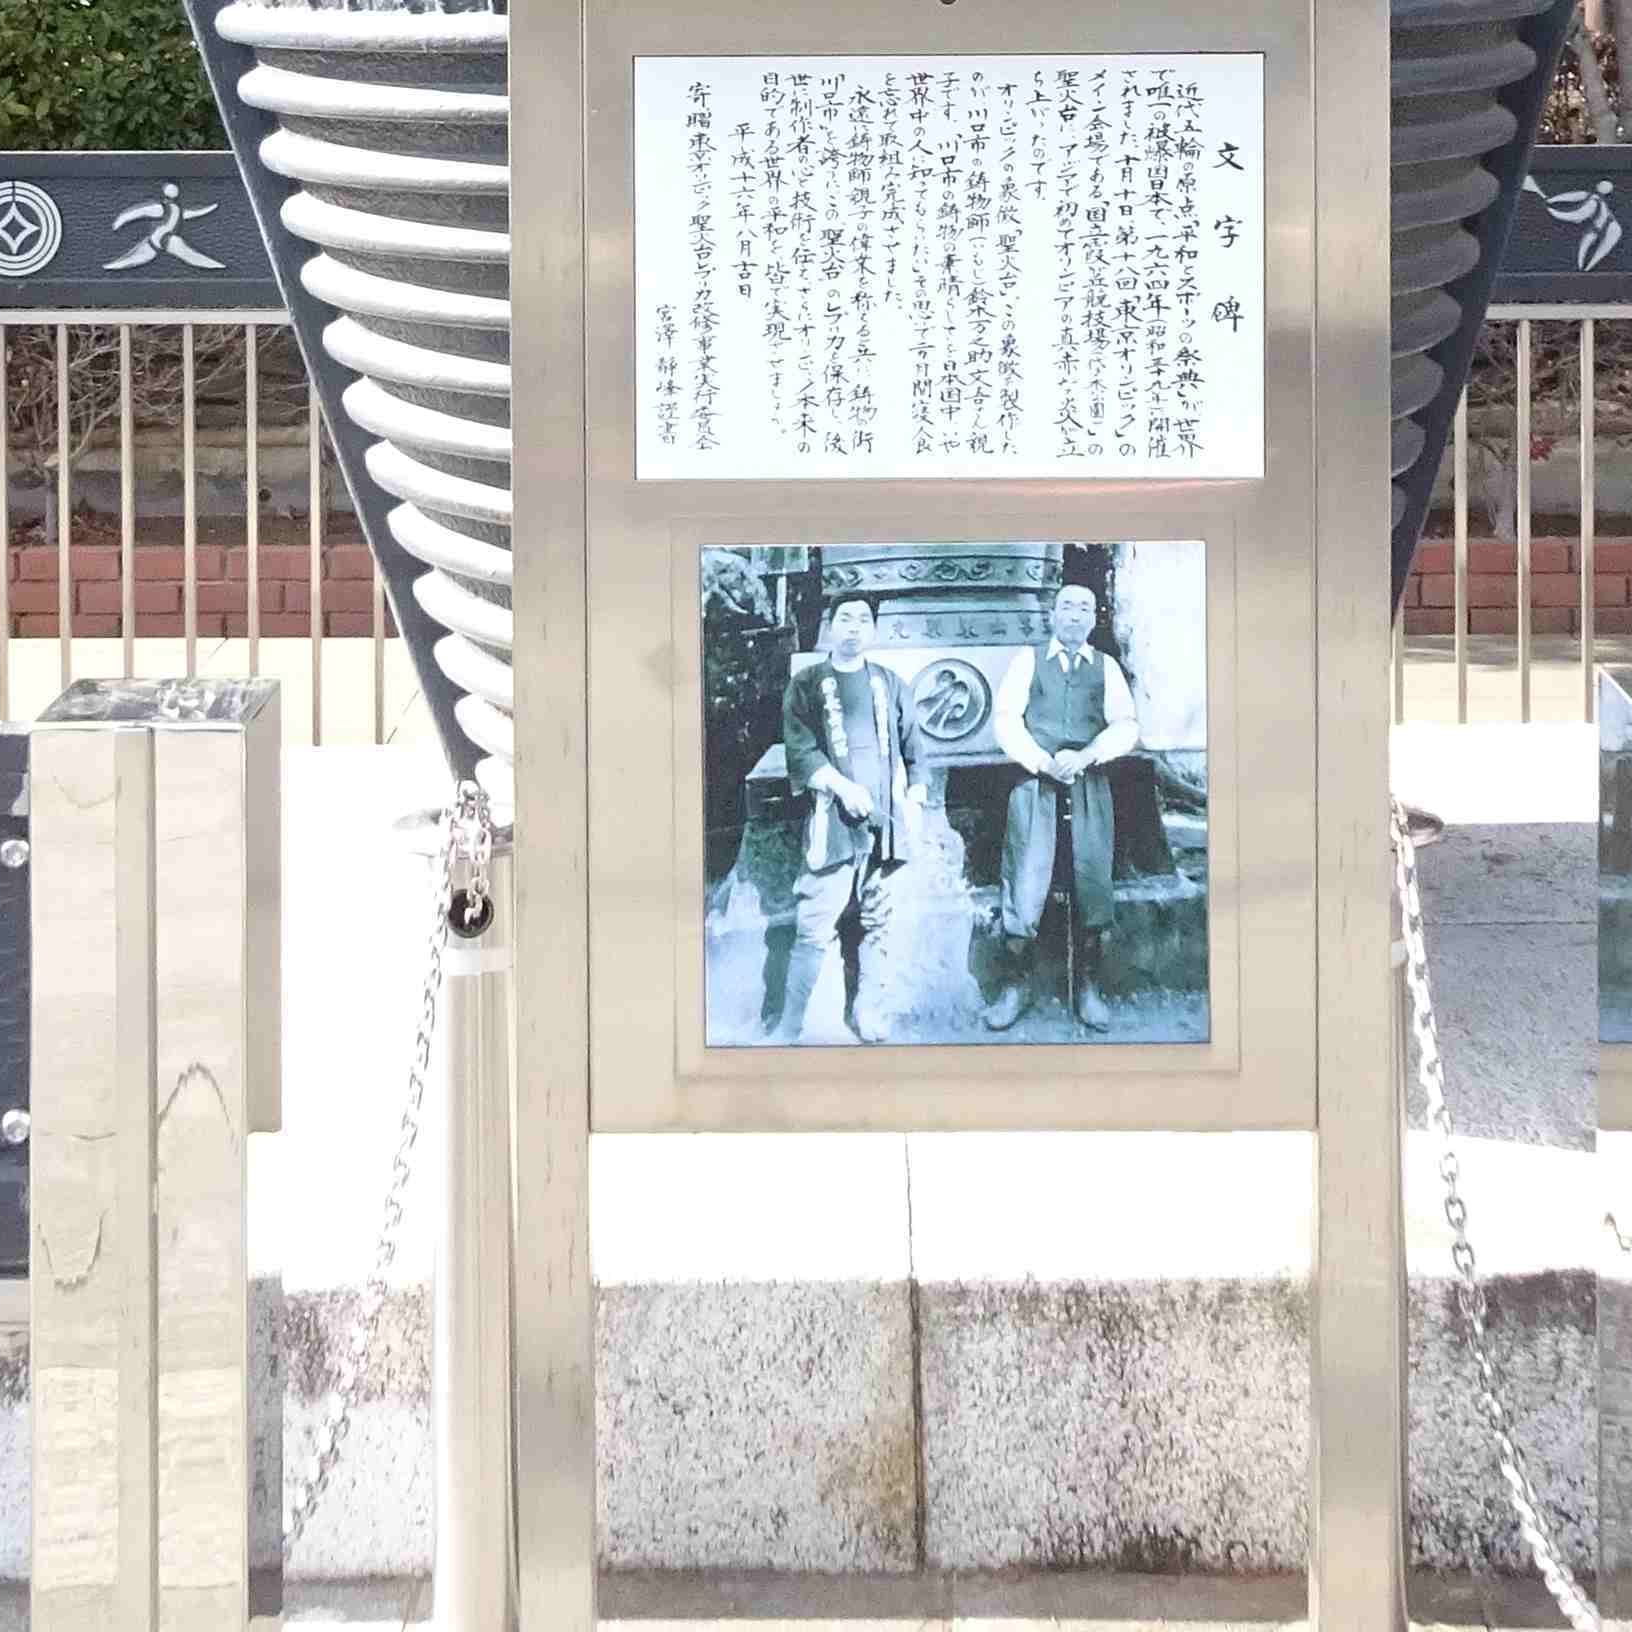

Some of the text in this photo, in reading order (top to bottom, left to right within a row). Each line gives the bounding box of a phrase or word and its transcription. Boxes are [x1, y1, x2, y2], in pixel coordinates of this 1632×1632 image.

[728, 121, 759, 299] 平成十六年八月吉日
[1211, 141, 1245, 333] 文字碑
